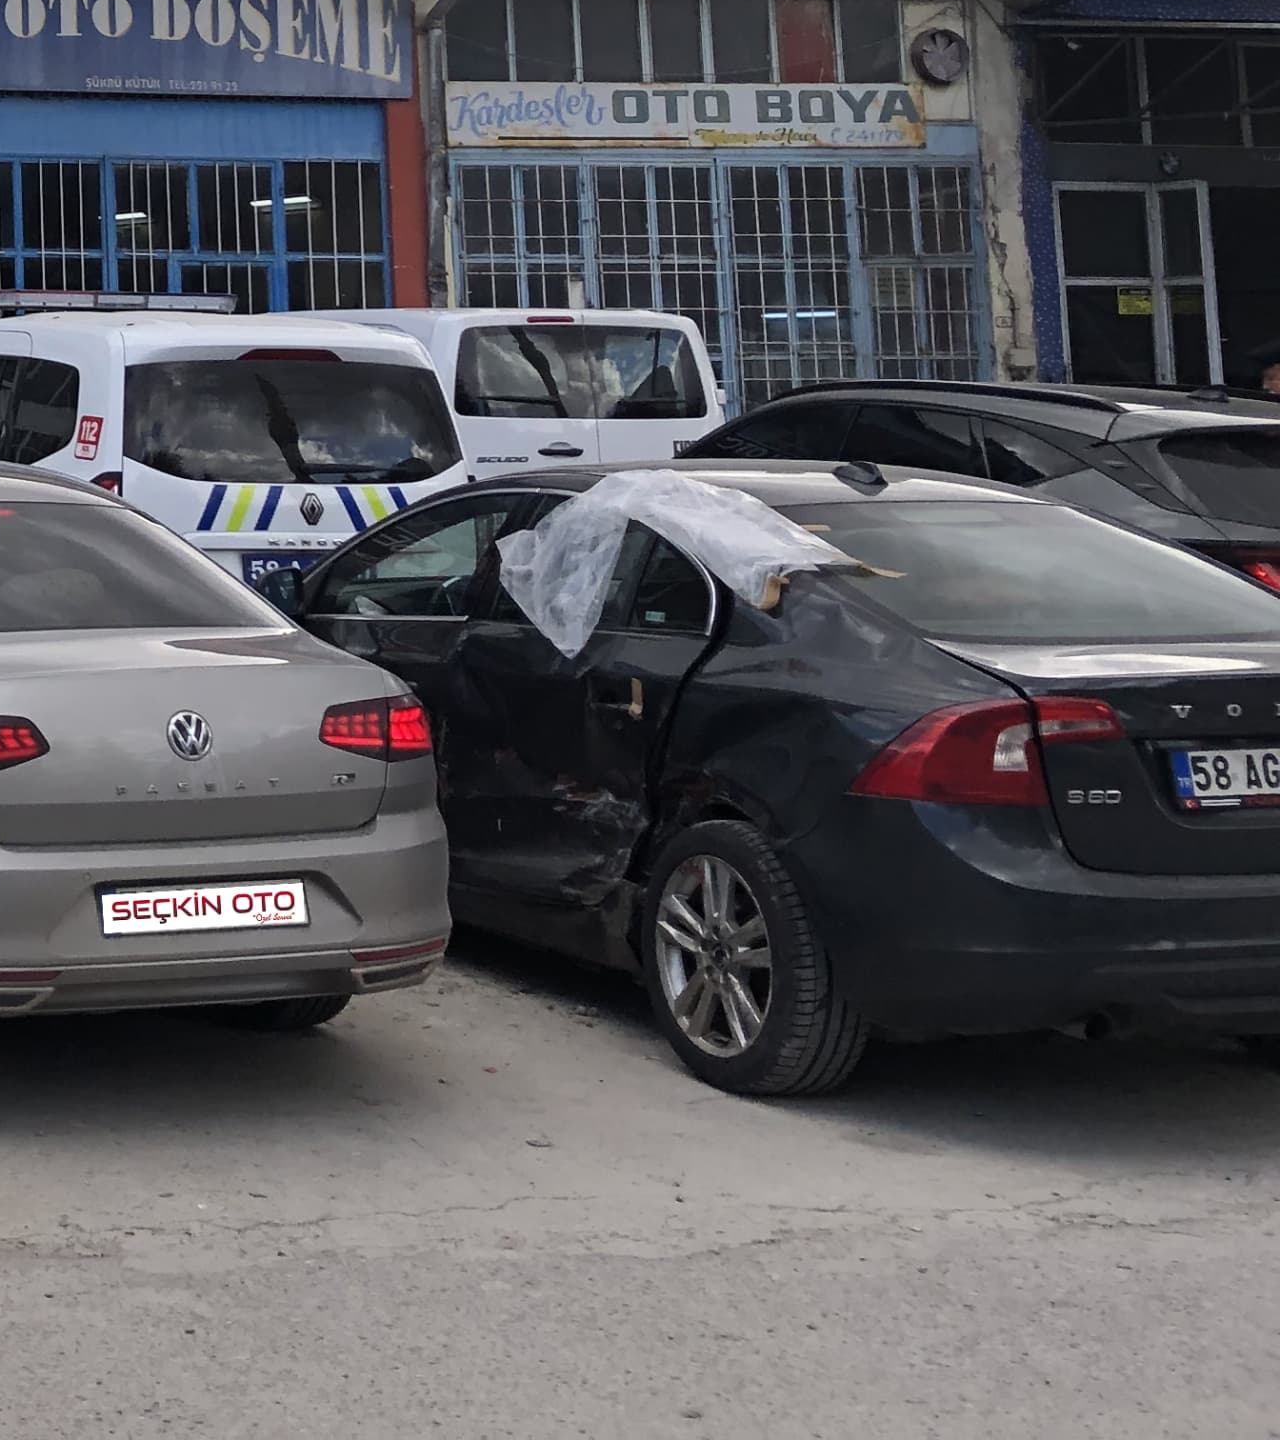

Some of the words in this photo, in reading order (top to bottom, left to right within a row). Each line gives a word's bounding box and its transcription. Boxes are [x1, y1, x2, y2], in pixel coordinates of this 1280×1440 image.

[612, 89, 731, 125] OTO
[756, 89, 921, 126] BOYA
[80, 420, 99, 442] 112
[476, 456, 529, 464] SCUDO
[1191, 754, 1233, 792] 58
